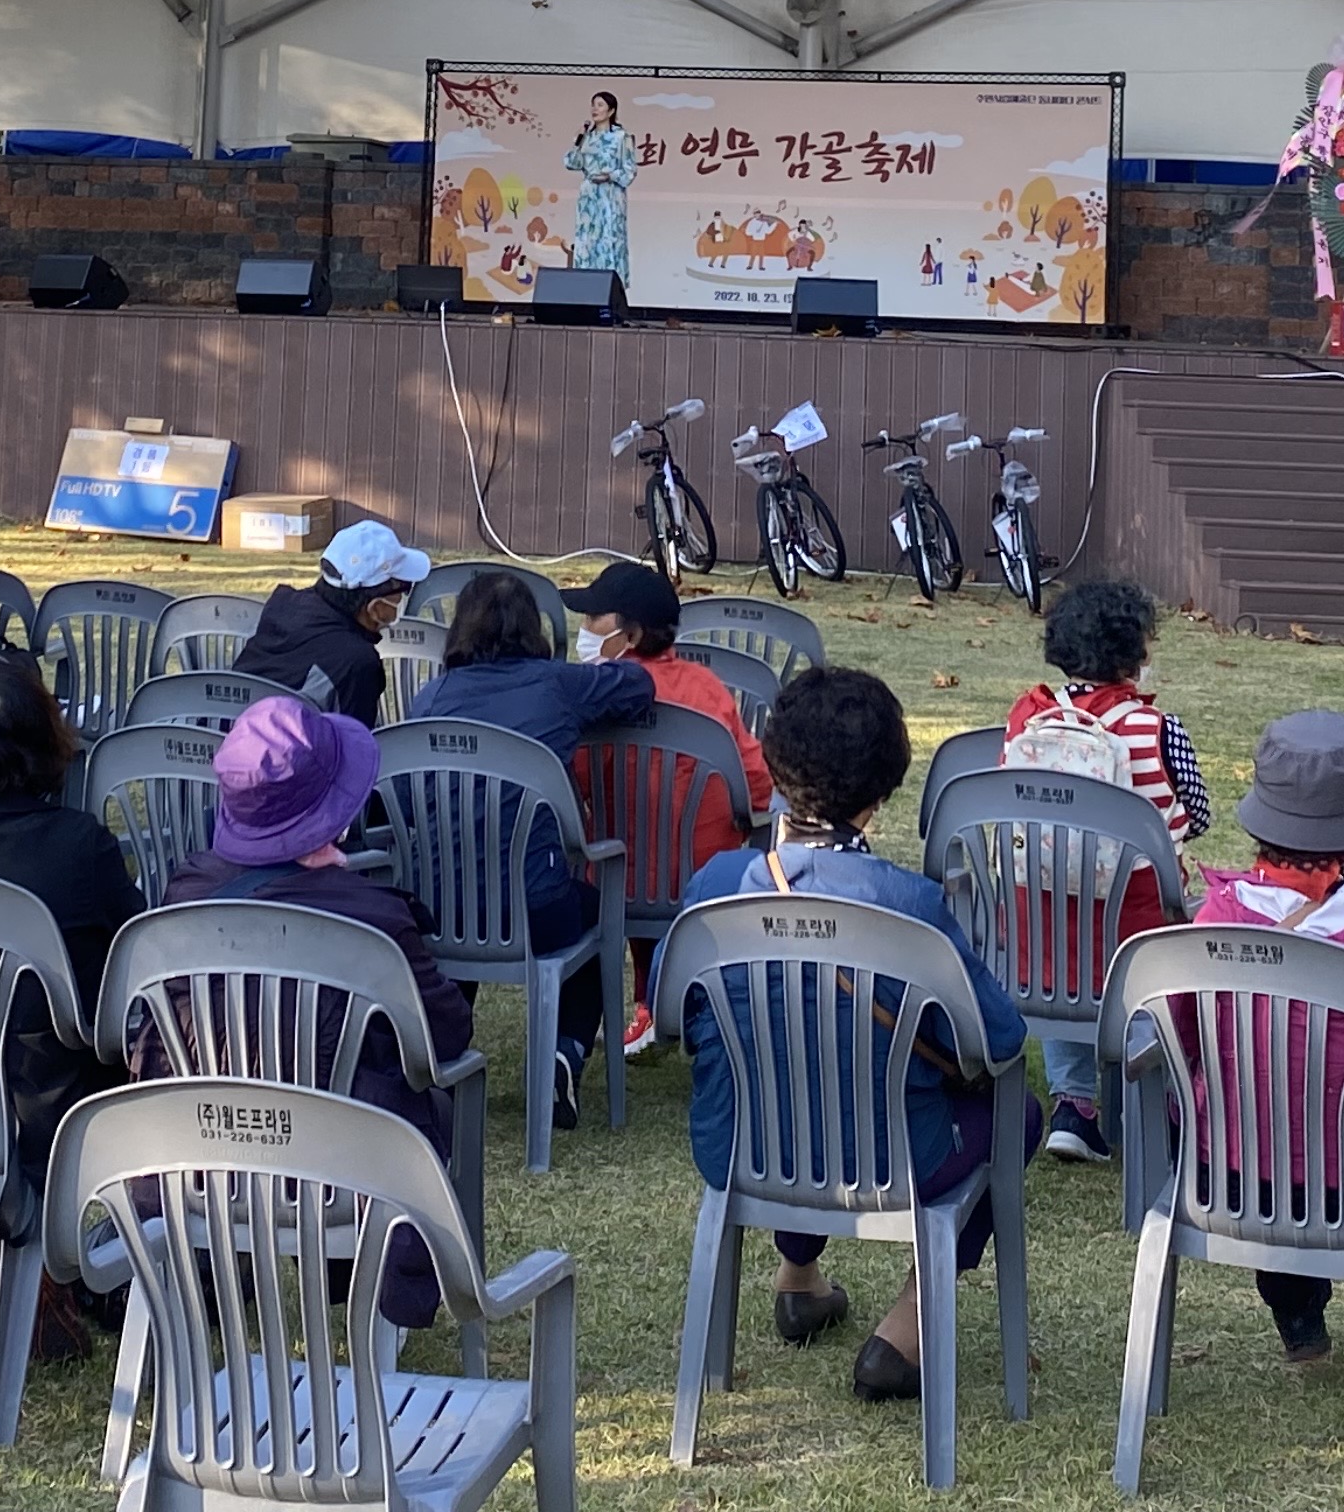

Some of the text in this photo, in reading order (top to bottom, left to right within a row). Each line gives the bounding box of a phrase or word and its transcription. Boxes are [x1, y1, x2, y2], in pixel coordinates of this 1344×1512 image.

[632, 133, 666, 167] 회
[167, 491, 199, 535] 5
[197, 1102, 291, 1134] (주)월드프라임
[200, 1129, 292, 1147] 031-226-6337
